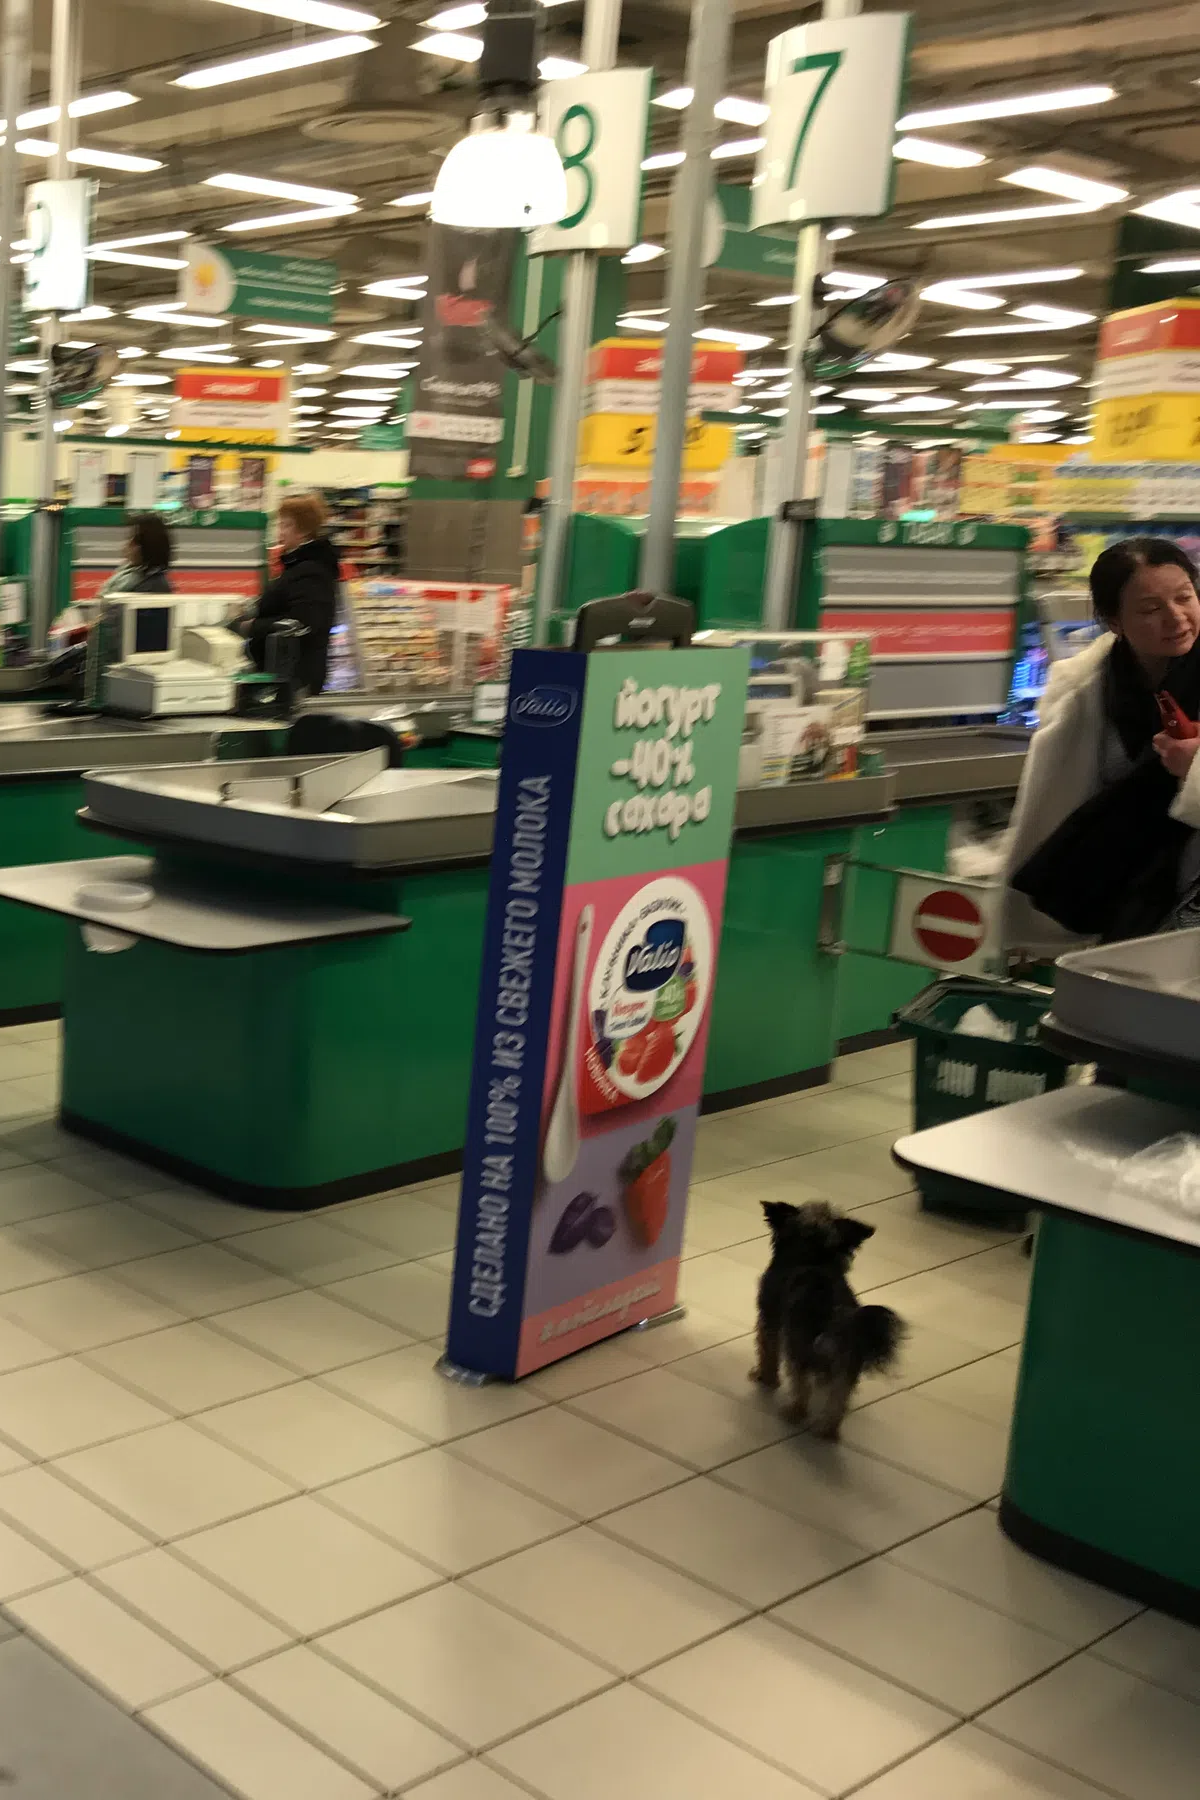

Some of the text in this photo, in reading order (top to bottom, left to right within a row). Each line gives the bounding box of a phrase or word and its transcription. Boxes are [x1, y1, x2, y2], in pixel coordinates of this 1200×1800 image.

[789, 50, 848, 191] 7
[513, 688, 569, 719] Valio
[610, 738, 696, 789] -40%
[626, 940, 681, 978] Valio
[468, 774, 552, 1318] СДЕЛАНО НА 100% ИЗ СВЕЖЕГО МОЛОКА
